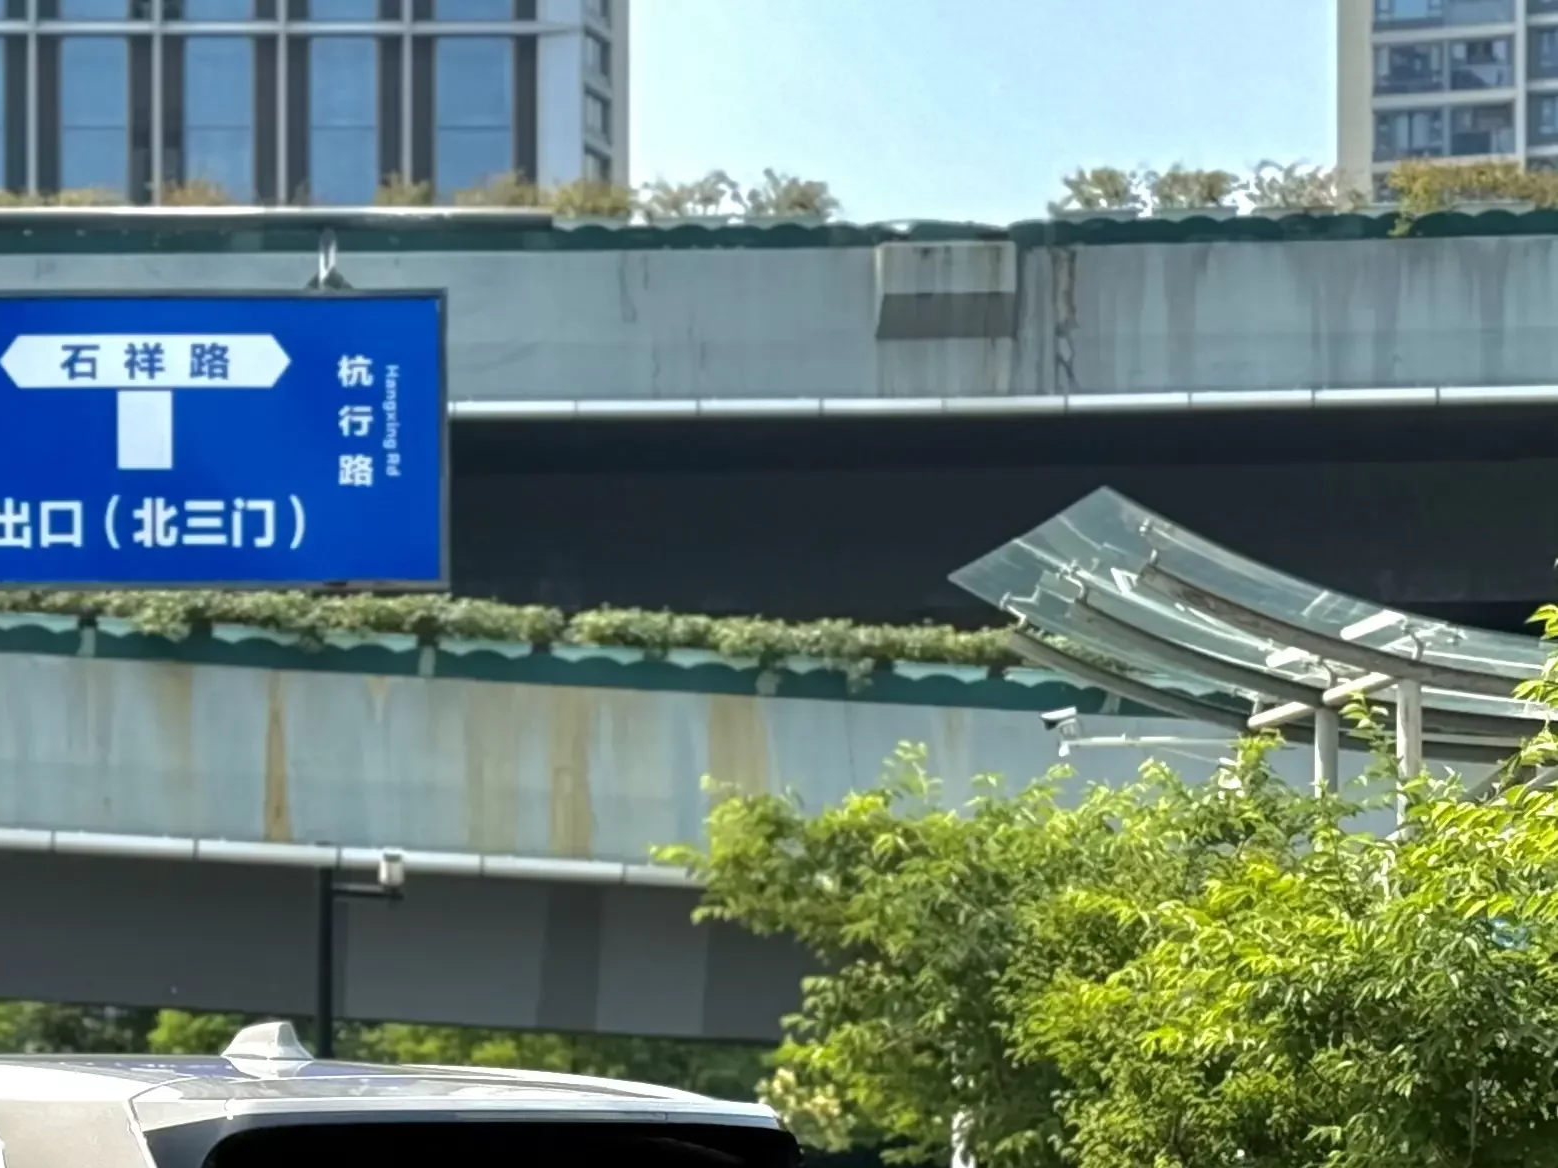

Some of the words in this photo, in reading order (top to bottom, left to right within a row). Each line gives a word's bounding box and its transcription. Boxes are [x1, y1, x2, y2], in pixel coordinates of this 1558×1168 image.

[59, 341, 230, 381] 石祥路
[337, 354, 374, 487] 杭行路
[382, 364, 400, 450] Hangxing
[385, 452, 402, 477] Rd
